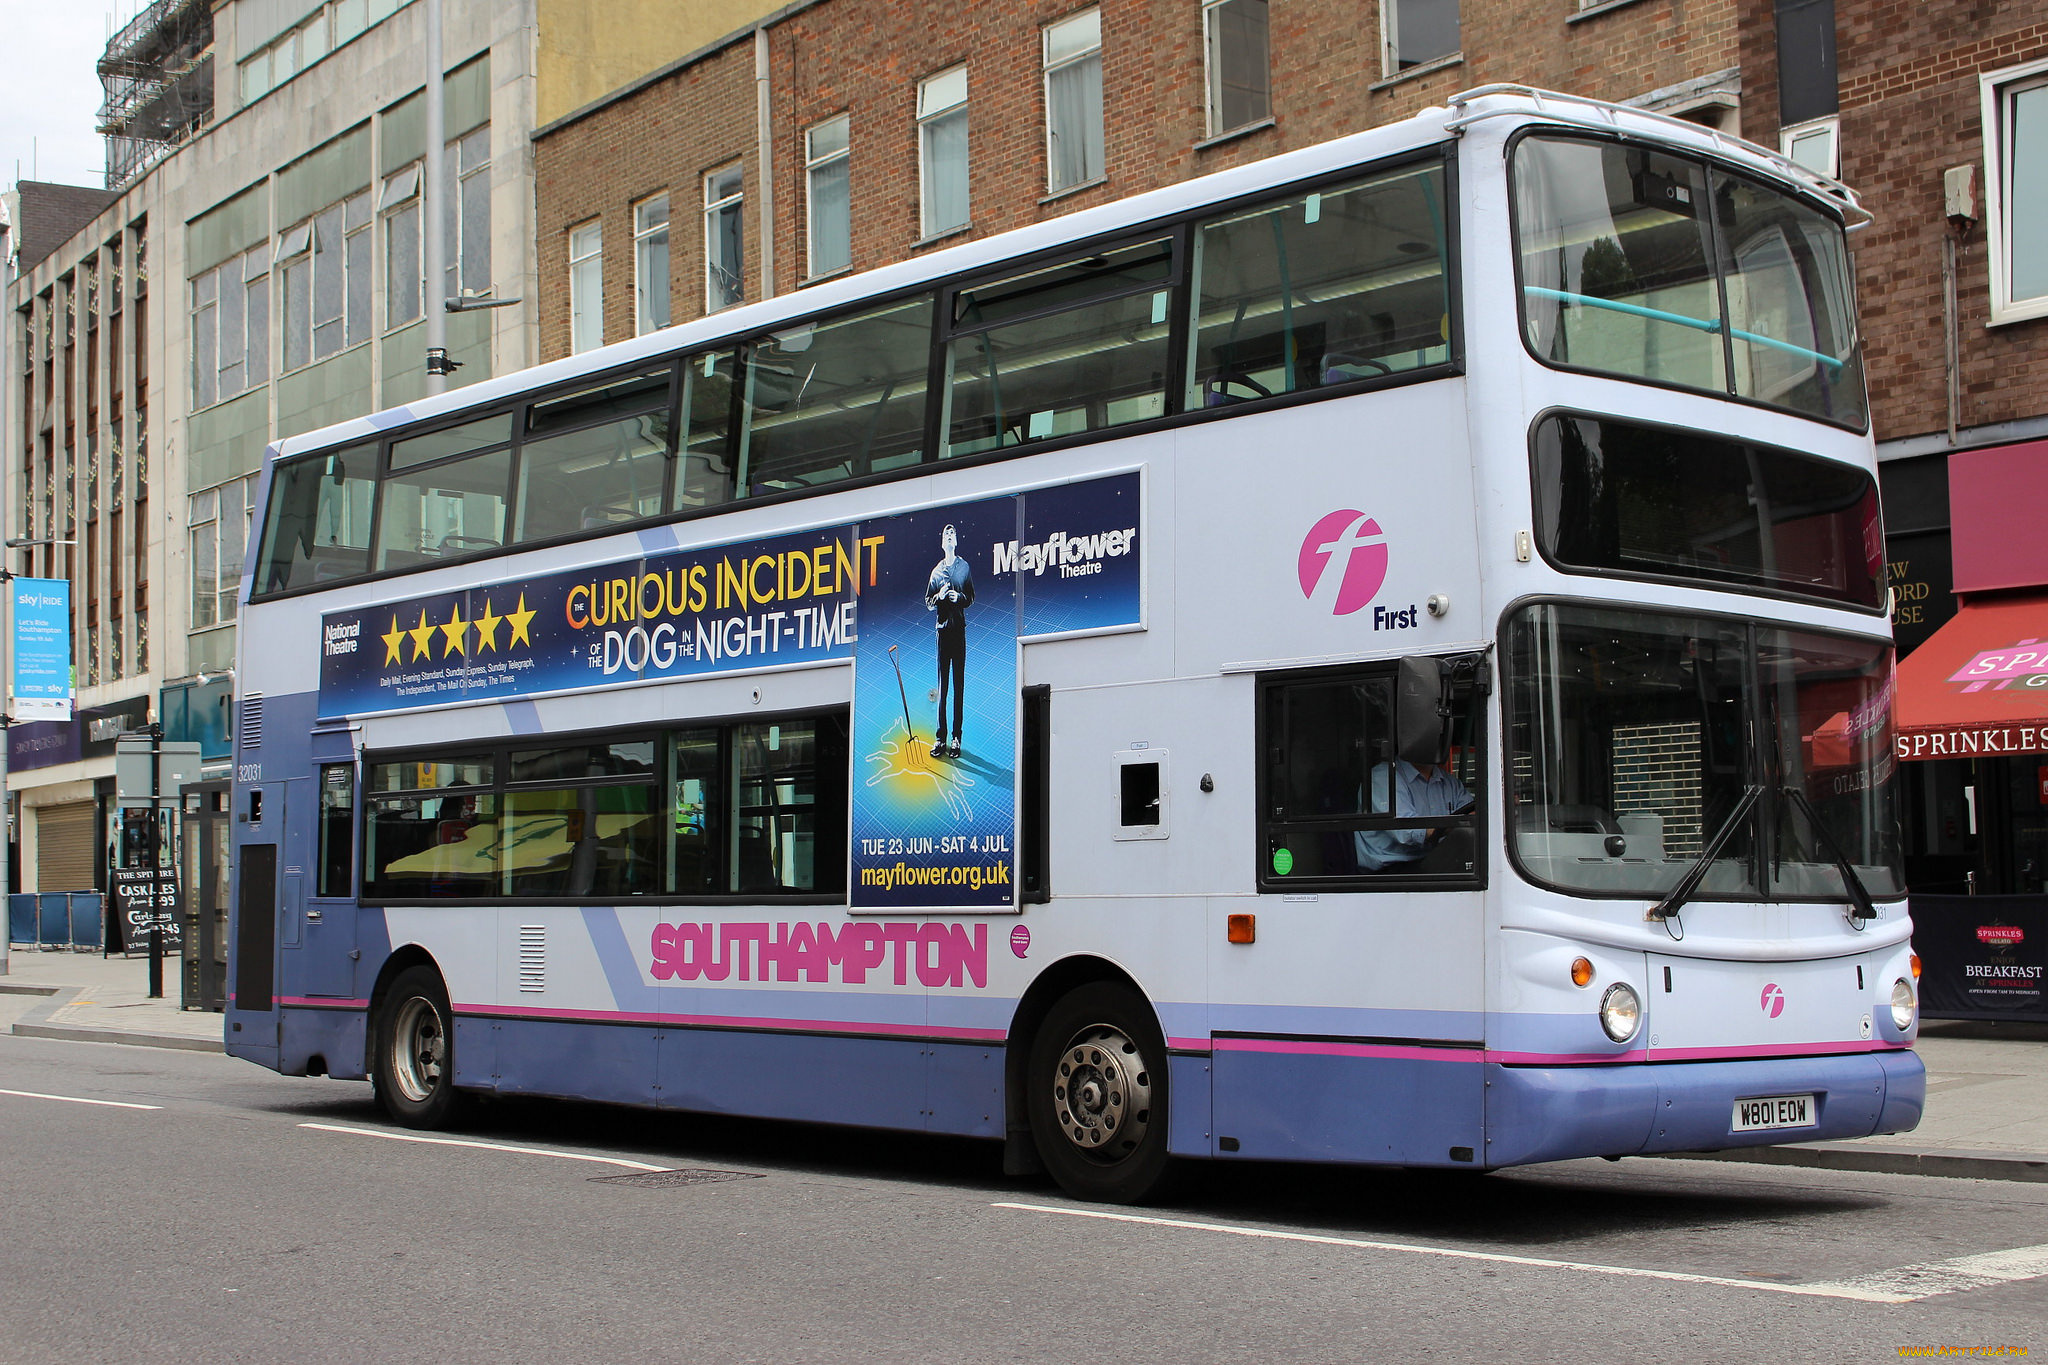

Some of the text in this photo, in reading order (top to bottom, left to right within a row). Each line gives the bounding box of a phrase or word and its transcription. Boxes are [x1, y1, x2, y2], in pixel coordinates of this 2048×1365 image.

[993, 527, 1136, 576] Mayflower
[1060, 561, 1102, 579] Theatre
[566, 565, 708, 630] CURIOUS
[716, 535, 885, 613] INCIDENT
[18, 594, 63, 607] sky RIDE
[1374, 604, 1418, 631] First
[19, 626, 62, 634] Southampton
[325, 620, 360, 640] National
[588, 600, 859, 675] OF THE DOG IN THE NIGHT-TIME
[325, 639, 357, 656] Theatre
[403, 674, 421, 684] Evening
[421, 669, 445, 680] Standard,
[446, 667, 466, 677] Sunday
[466, 666, 487, 676] Express,
[488, 662, 507, 672] Sunday
[508, 658, 535, 670] Telegraph,
[48, 684, 63, 695] sky
[396, 687, 405, 696] The
[405, 683, 436, 696] Independent,
[437, 681, 447, 691] The
[447, 680, 459, 690] Mail
[488, 676, 498, 685] The
[499, 674, 515, 684] Times
[239, 763, 262, 782] 32031
[862, 839, 885, 855] TUE
[889, 838, 903, 854] 23
[906, 837, 933, 854] JUN
[941, 836, 967, 853] SAT
[970, 836, 978, 852] 4
[982, 835, 1009, 853] JUL
[136, 870, 175, 878] SPITIRE
[861, 860, 1010, 891] mayflower.org.uk
[119, 885, 149, 897] CASK
[1977, 929, 2022, 938] SPRINKLES
[650, 921, 988, 988] SOUTHAMPTON
[1966, 965, 2043, 978] BREAKFAST
[1988, 979, 2034, 988] SPRINKLES
[1741, 1099, 1806, 1126] W801 EOW
